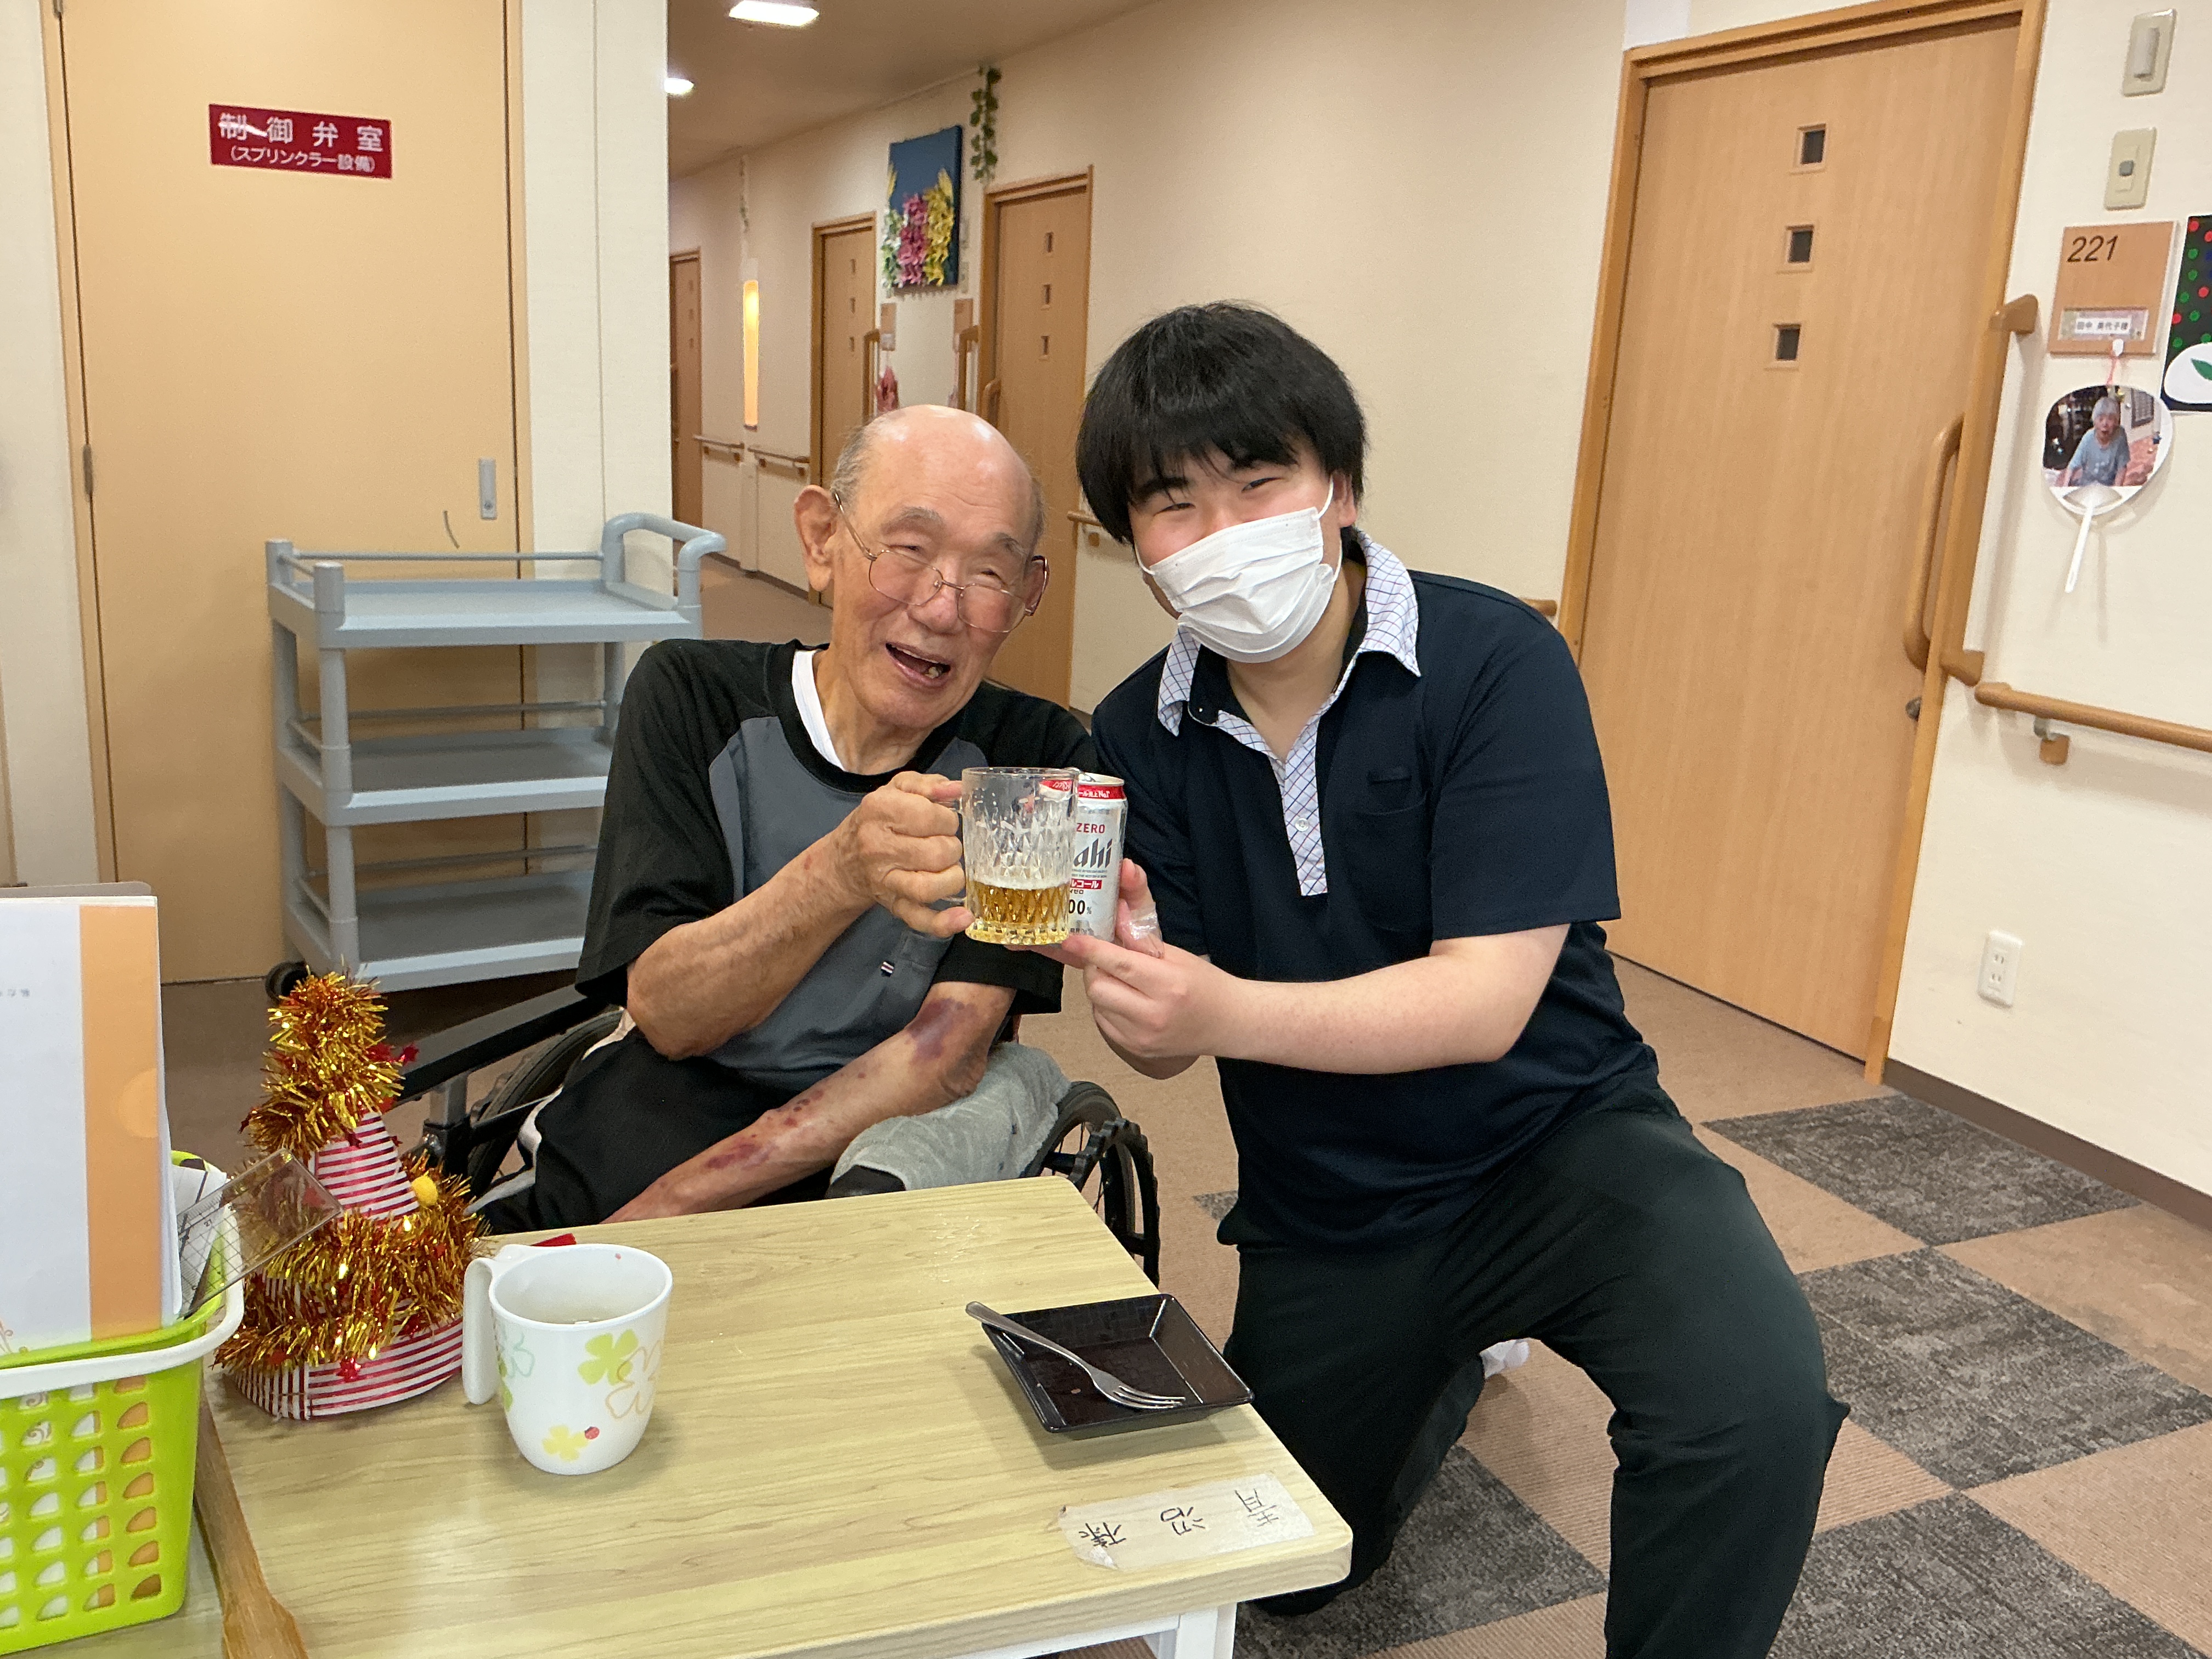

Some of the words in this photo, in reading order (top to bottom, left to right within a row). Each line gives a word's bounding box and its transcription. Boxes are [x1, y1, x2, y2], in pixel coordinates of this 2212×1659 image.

[219, 112, 383, 153] 制御弁室
[2067, 235, 2118, 263] 221
[1076, 823, 1105, 834] ZERO
